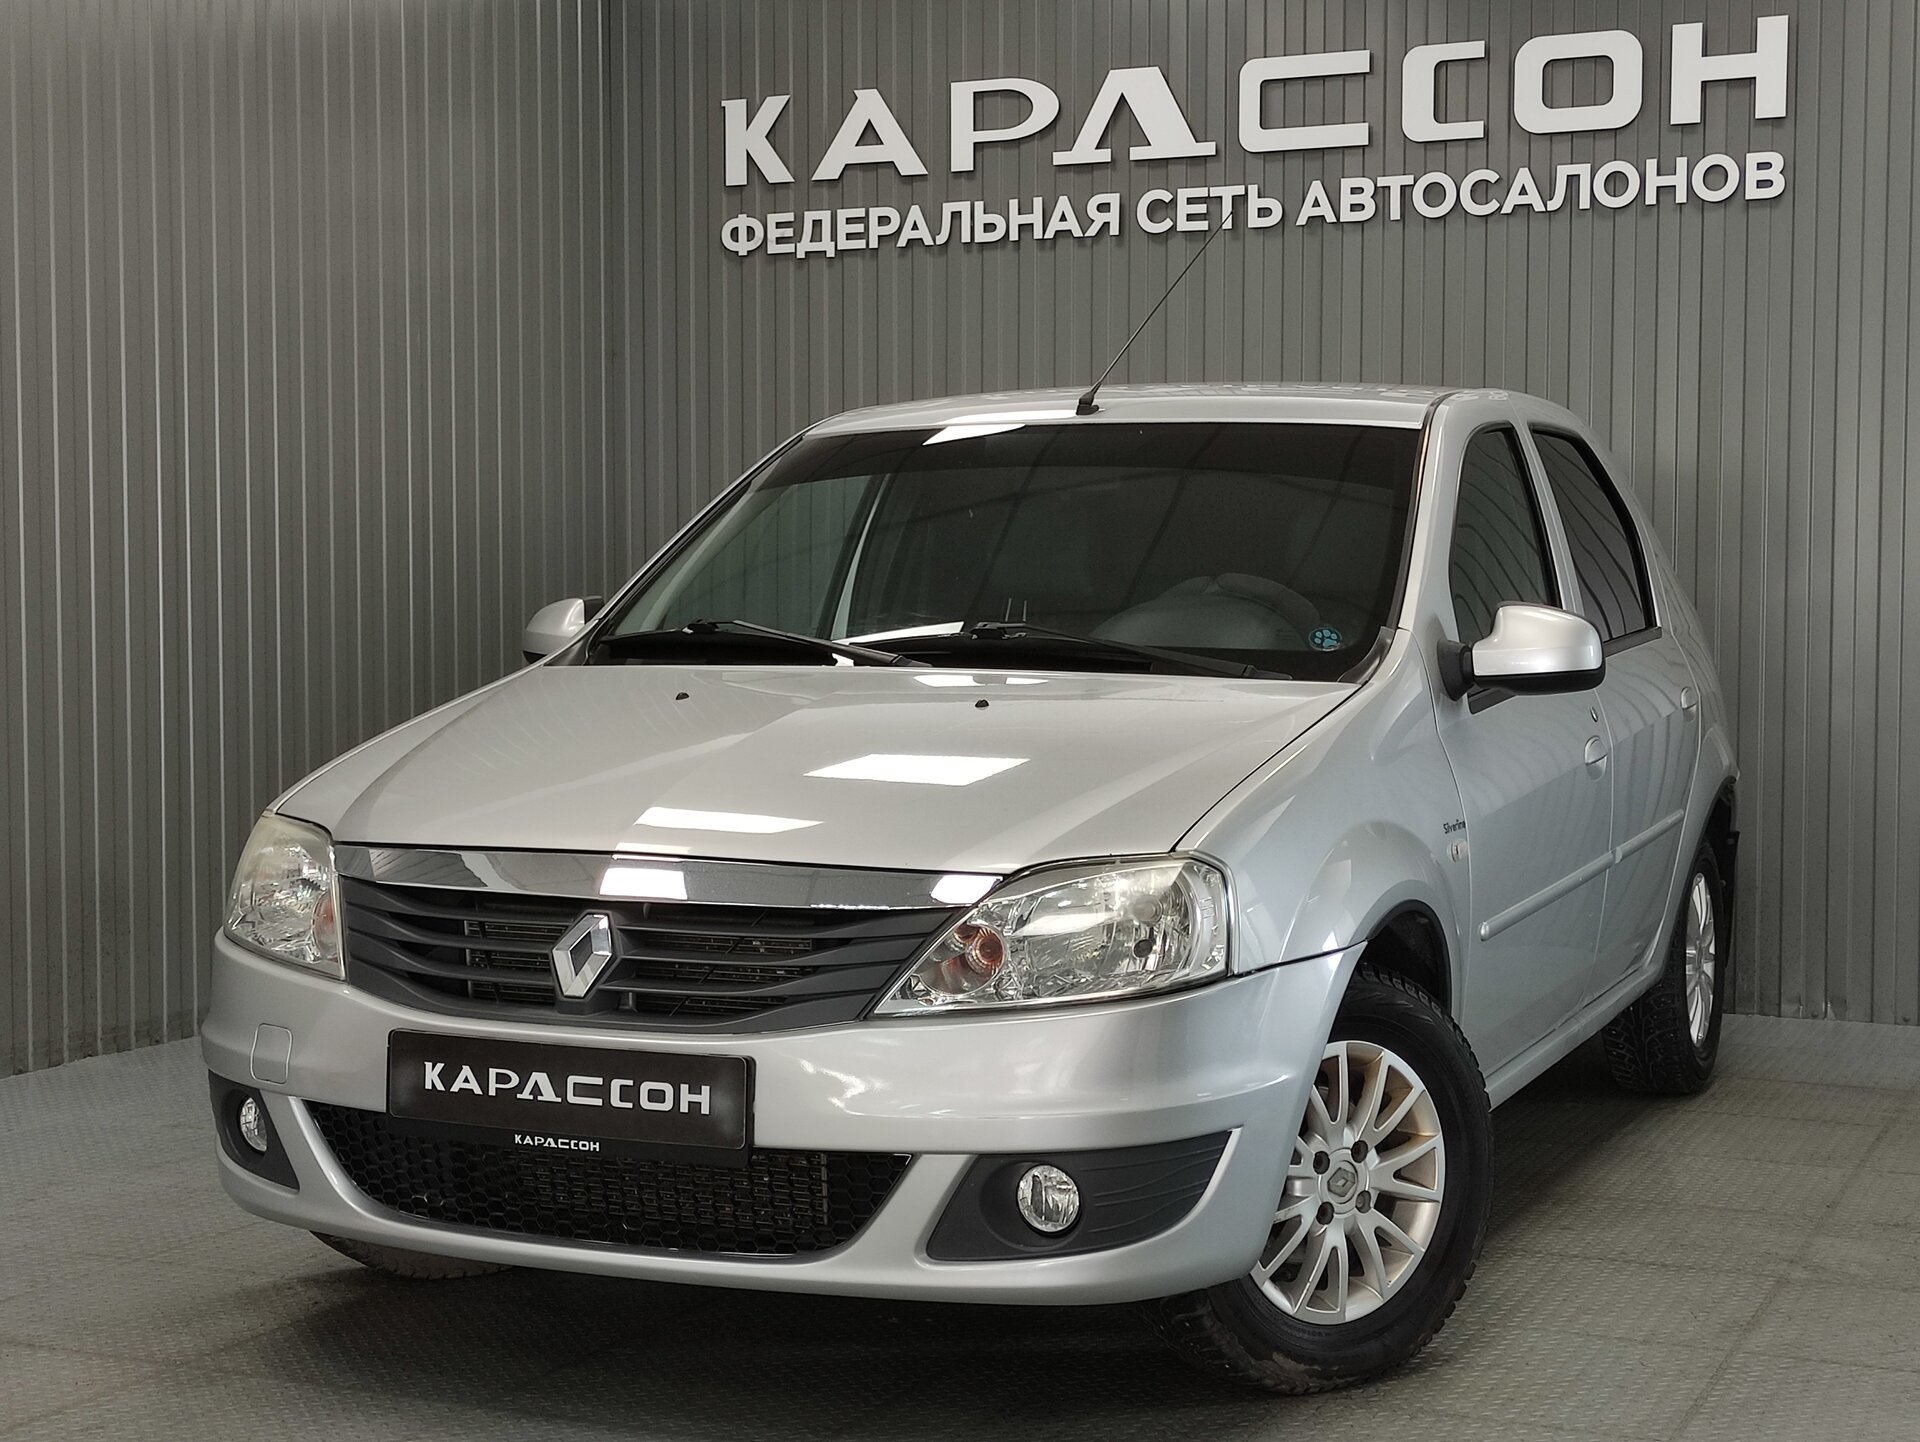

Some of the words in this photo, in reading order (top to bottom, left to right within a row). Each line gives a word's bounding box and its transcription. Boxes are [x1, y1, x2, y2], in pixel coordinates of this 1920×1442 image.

[721, 15, 1789, 186] КАРАССОН
[721, 193, 1120, 258] ФЕДЕРАЛЬНАЯ
[1136, 184, 1284, 234] СЕТЬ
[1296, 151, 1786, 225] АВТОСАЛОНОВ
[424, 1061, 711, 1115] КАРАССОН
[514, 1134, 600, 1152] КАРАССОН
